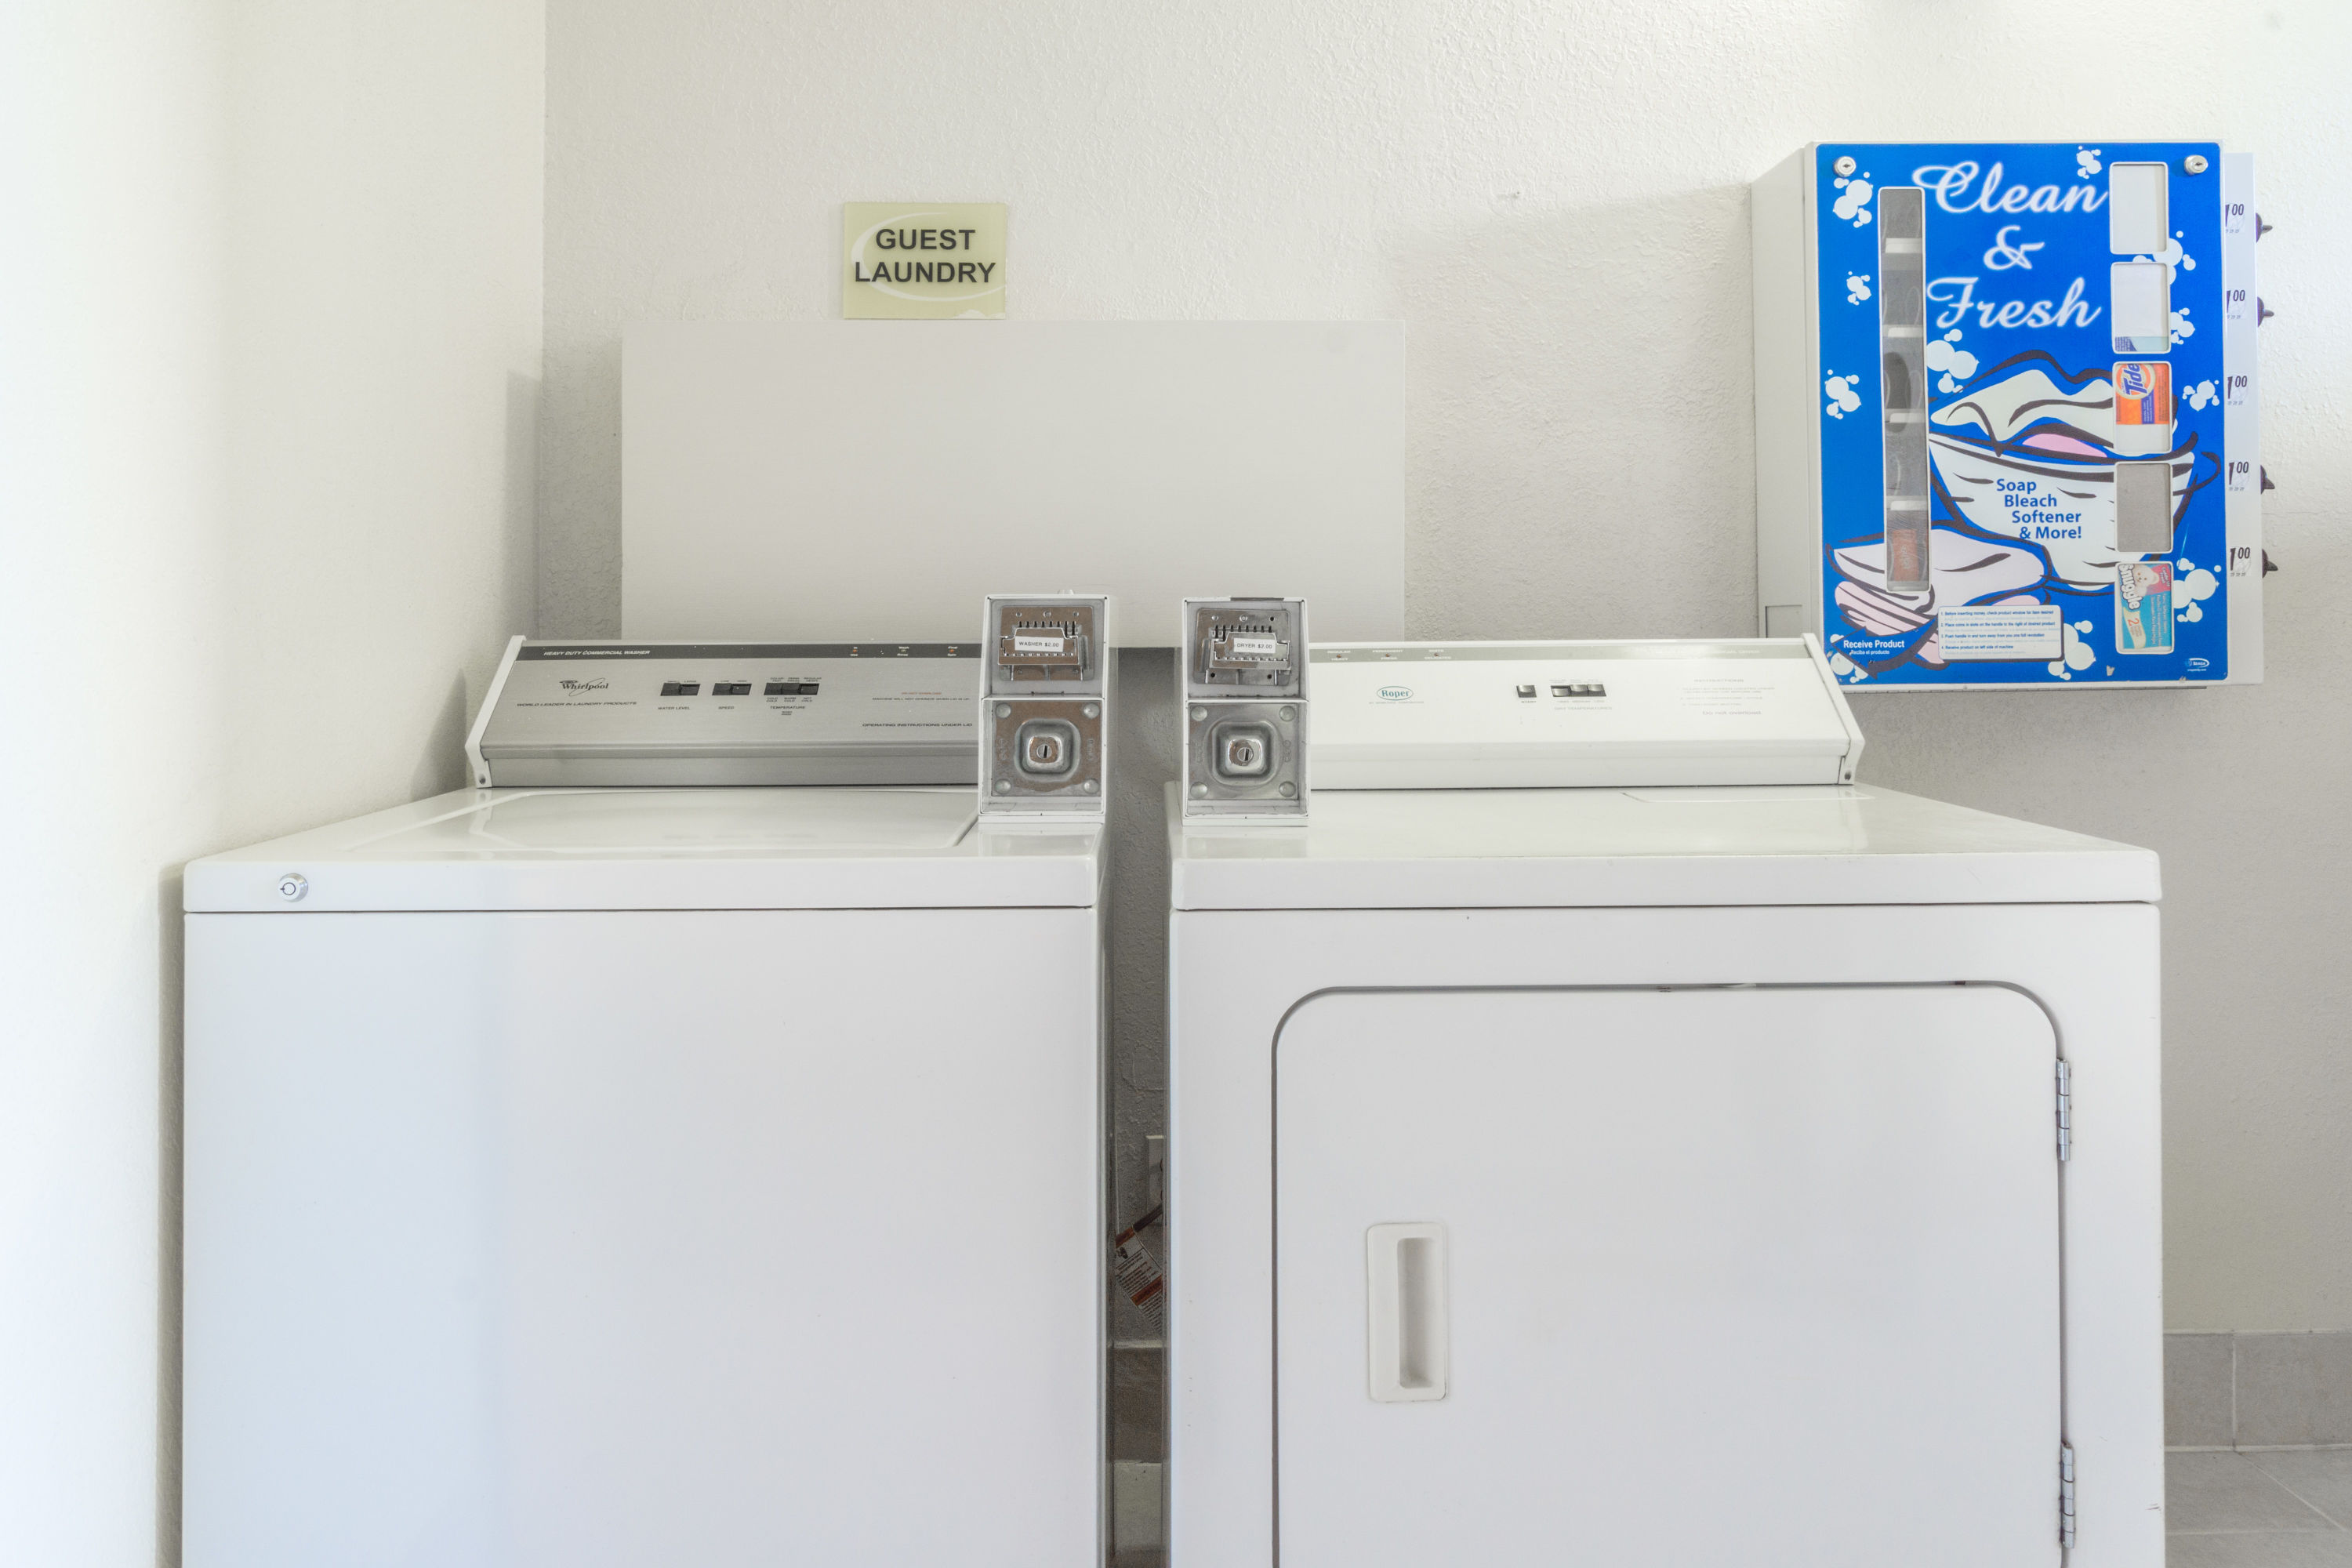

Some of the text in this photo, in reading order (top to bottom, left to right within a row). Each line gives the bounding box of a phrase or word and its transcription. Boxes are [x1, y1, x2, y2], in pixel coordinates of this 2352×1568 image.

[1912, 161, 2109, 213] Clean
[876, 228, 976, 250] GUEST
[1984, 225, 2045, 270] &
[855, 261, 996, 283] LAUNDRY
[1926, 276, 2101, 328] Fresh
[2123, 364, 2147, 396] Tide
[1996, 477, 2037, 495] Soap
[2004, 493, 2057, 507] Bleach
[2012, 509, 2082, 524] Softener
[2019, 526, 2082, 539] & More!
[2118, 564, 2143, 610] Snuggle
[1843, 640, 1905, 648] Receive Product
[561, 681, 608, 691] Whirlpool
[1381, 688, 1410, 699] Roper
